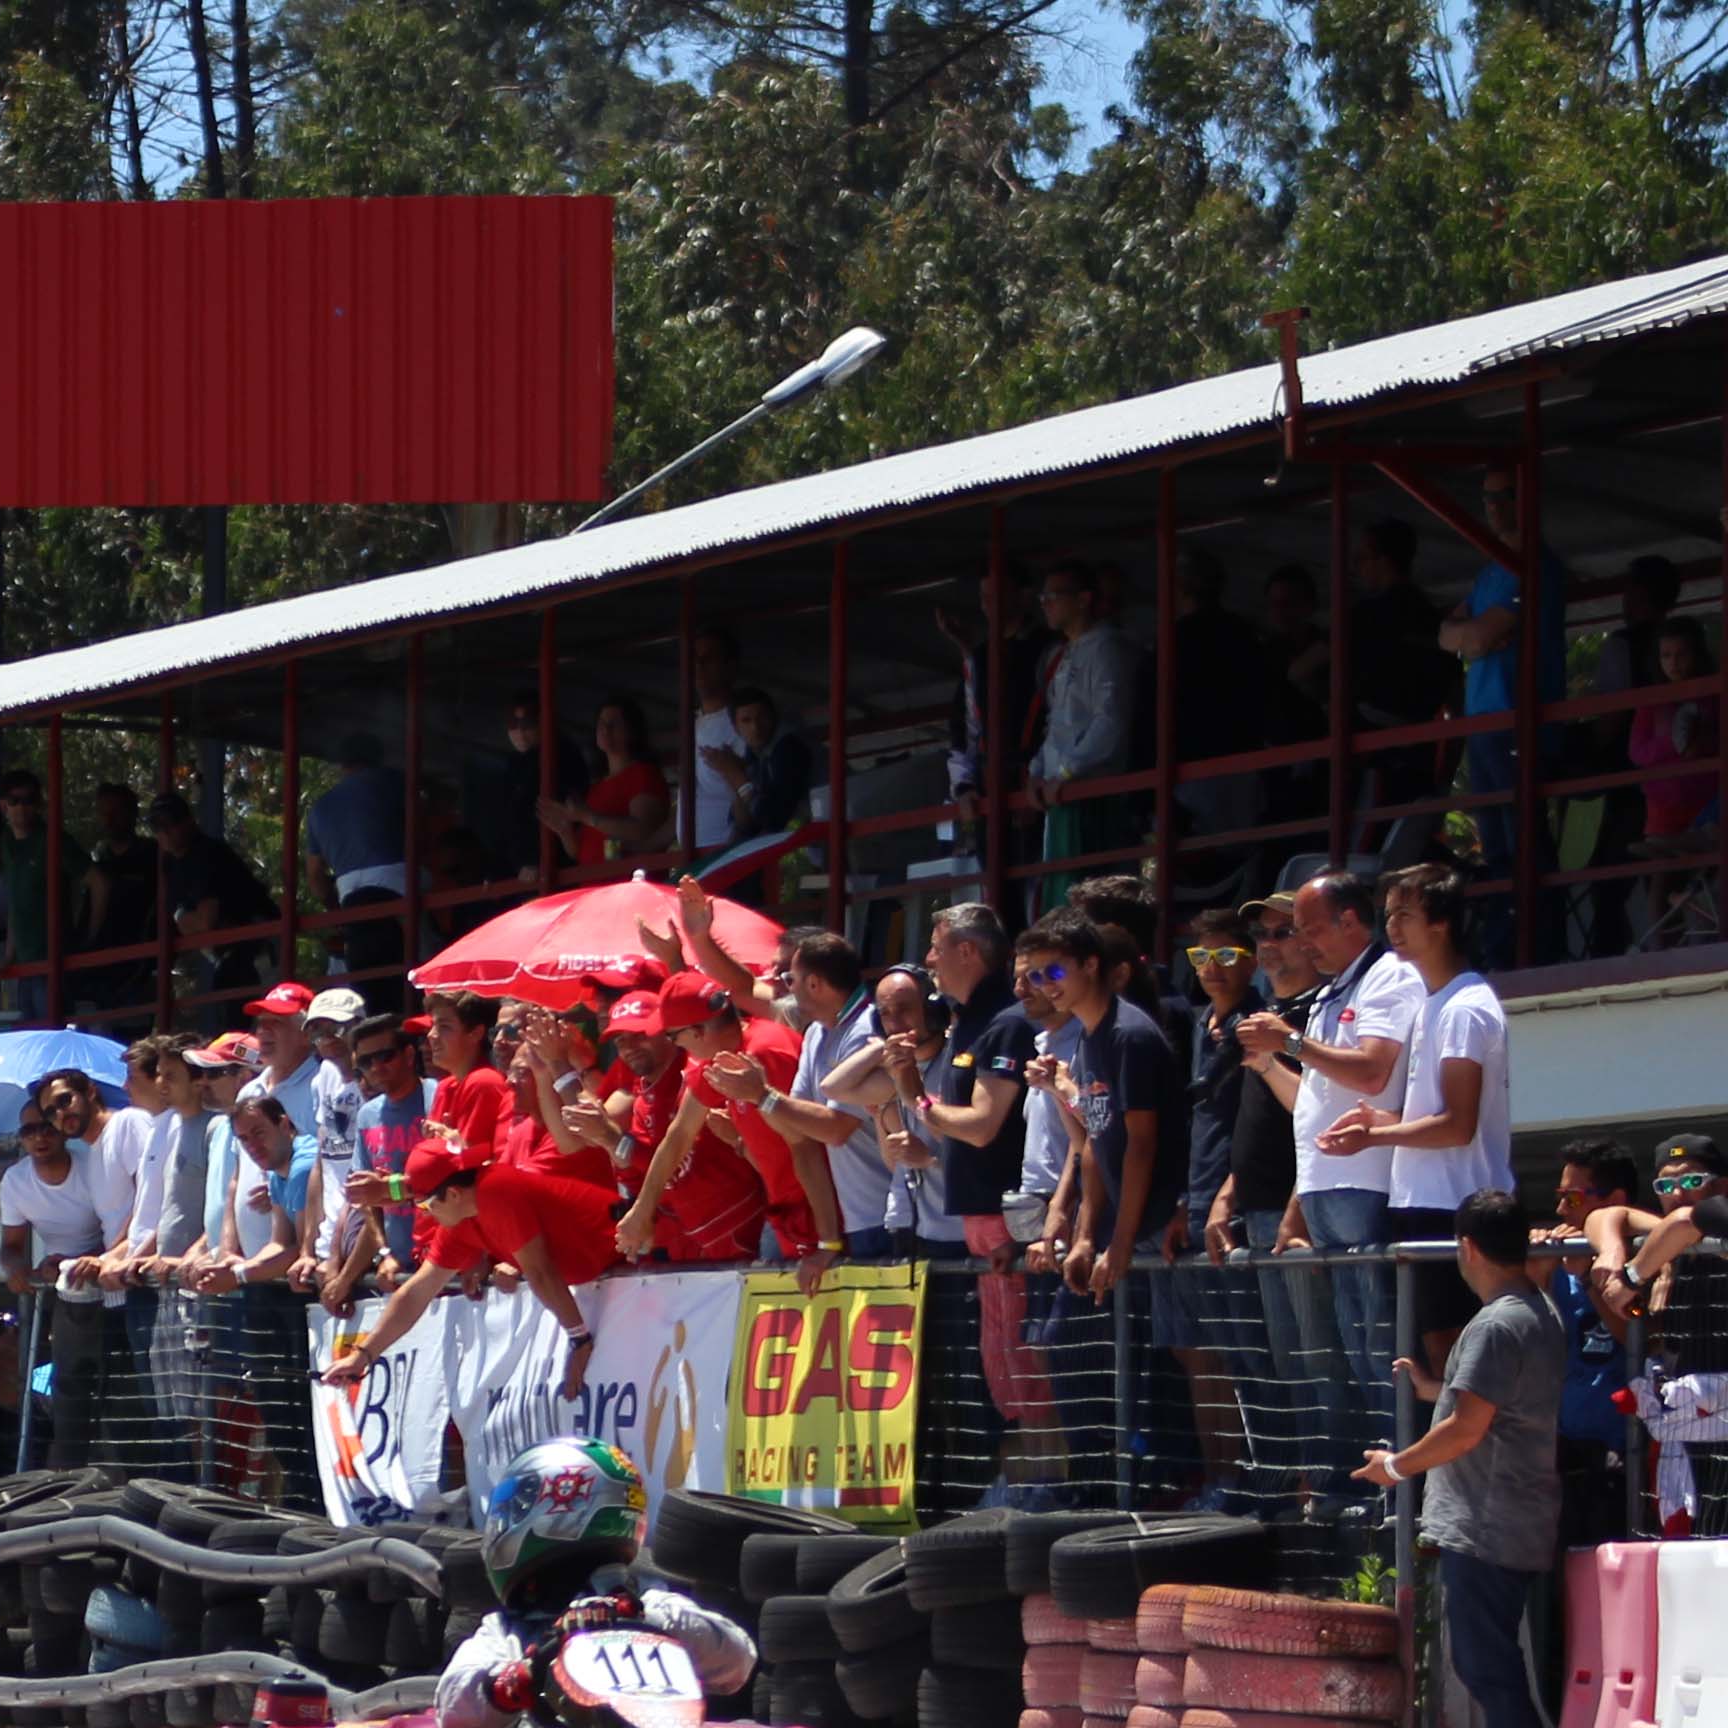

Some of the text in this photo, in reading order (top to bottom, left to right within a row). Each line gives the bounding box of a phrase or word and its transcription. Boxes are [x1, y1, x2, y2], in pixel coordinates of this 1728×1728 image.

[741, 1303, 917, 1417] GAS
[735, 1442, 907, 1485] RACING TEAM
[592, 1643, 673, 1689] 111
